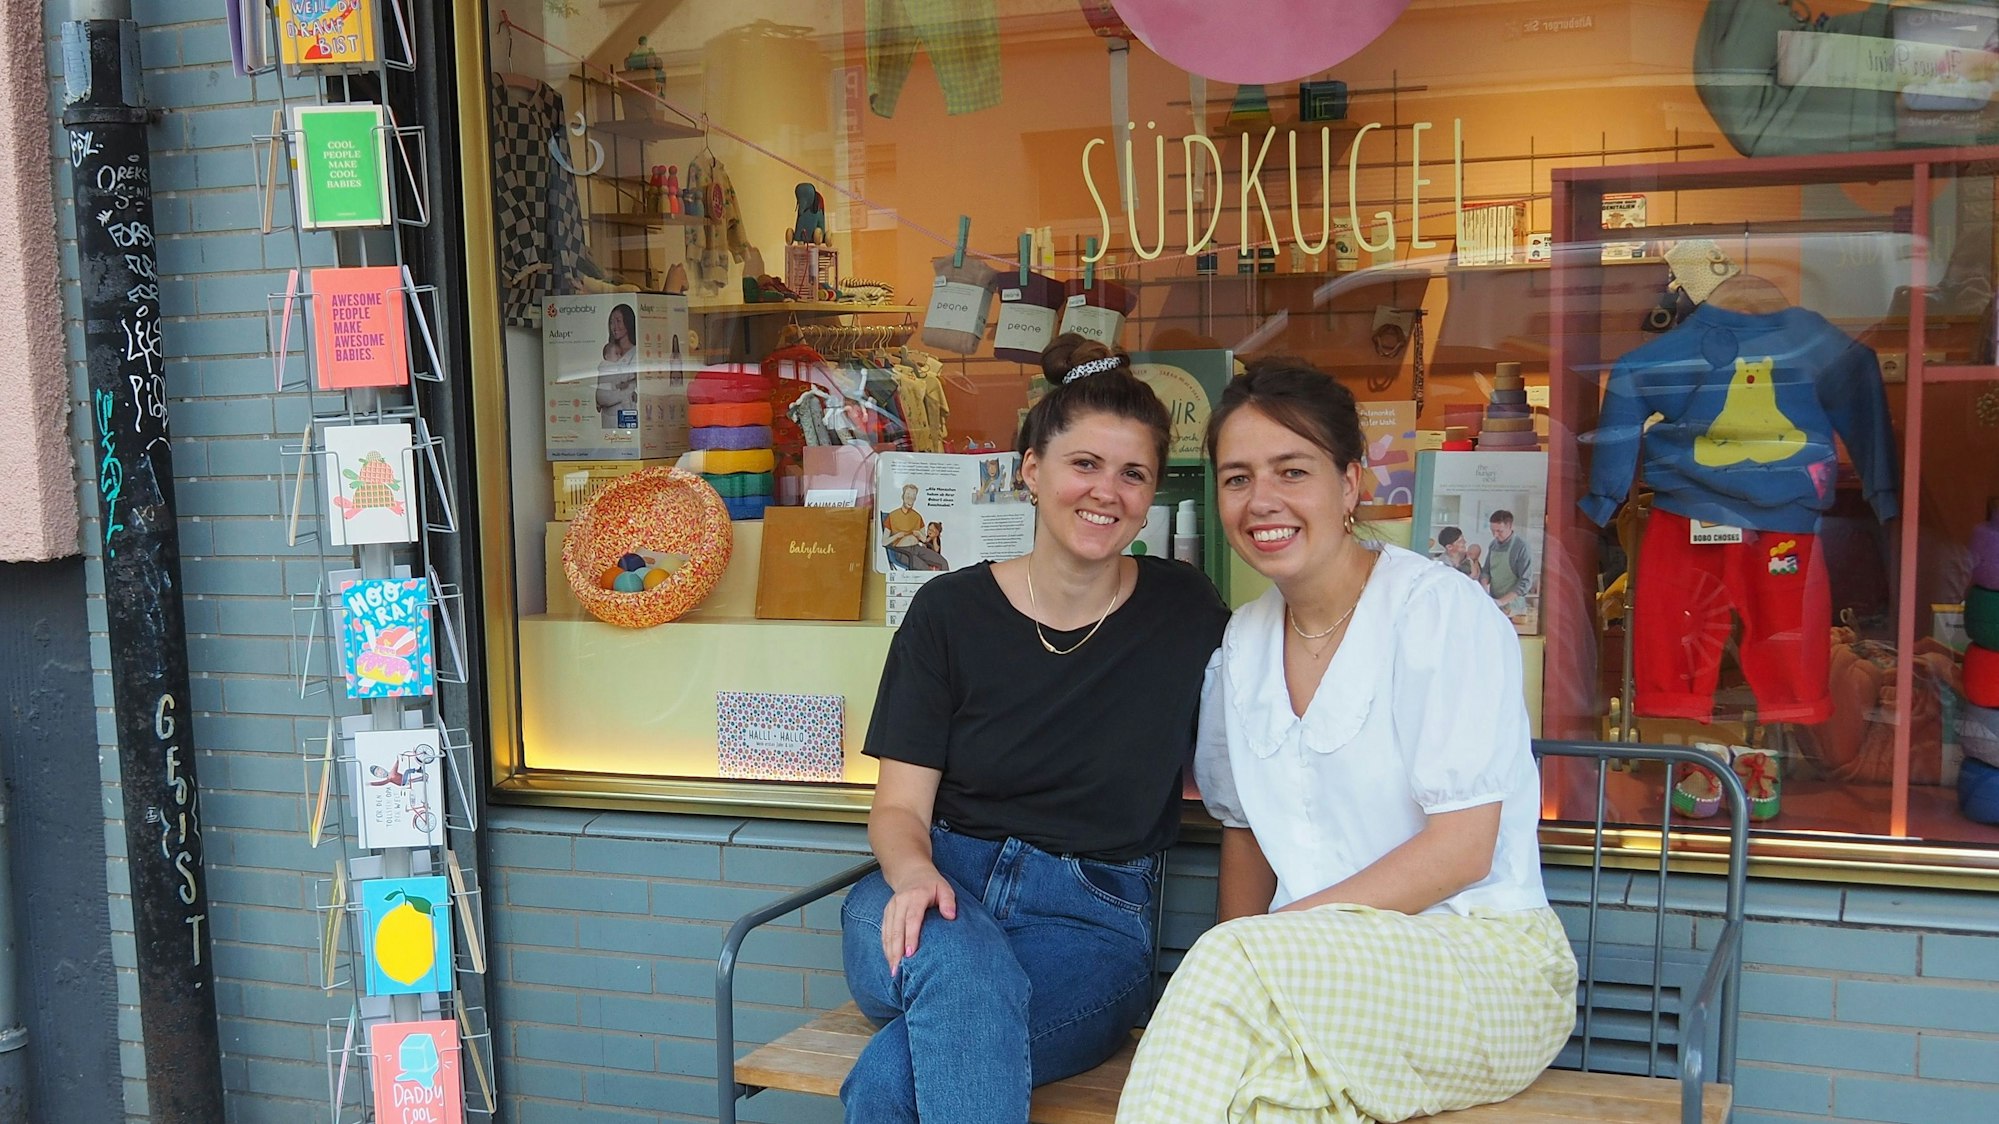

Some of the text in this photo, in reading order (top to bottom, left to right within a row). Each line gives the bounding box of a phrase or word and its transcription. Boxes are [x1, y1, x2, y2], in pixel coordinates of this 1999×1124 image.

[291, 0, 362, 14] WEIL DU
[286, 18, 345, 38] DRAUF
[318, 34, 359, 55] BIST
[327, 140, 355, 149] COOL
[323, 150, 361, 159] PEOPLE
[328, 160, 357, 169] MAKE
[330, 170, 357, 178] COOL
[327, 179, 362, 188] BABIES
[1081, 118, 1479, 263] SÜDKUGEL
[332, 293, 382, 307] AWESOME
[333, 307, 371, 320] PEOPLE
[559, 304, 597, 316] ergobaby
[334, 321, 362, 334] MAKE
[335, 334, 385, 348] AWESOME
[336, 348, 375, 361] BABIES.
[1713, 533, 1740, 541] CHOSES
[789, 541, 836, 559] Babybuch
[348, 581, 401, 617] HOO
[375, 596, 415, 626] RAY
[749, 730, 804, 743] HALLI HALLO
[393, 1083, 444, 1108] DADDY
[403, 1107, 438, 1124] COOL
